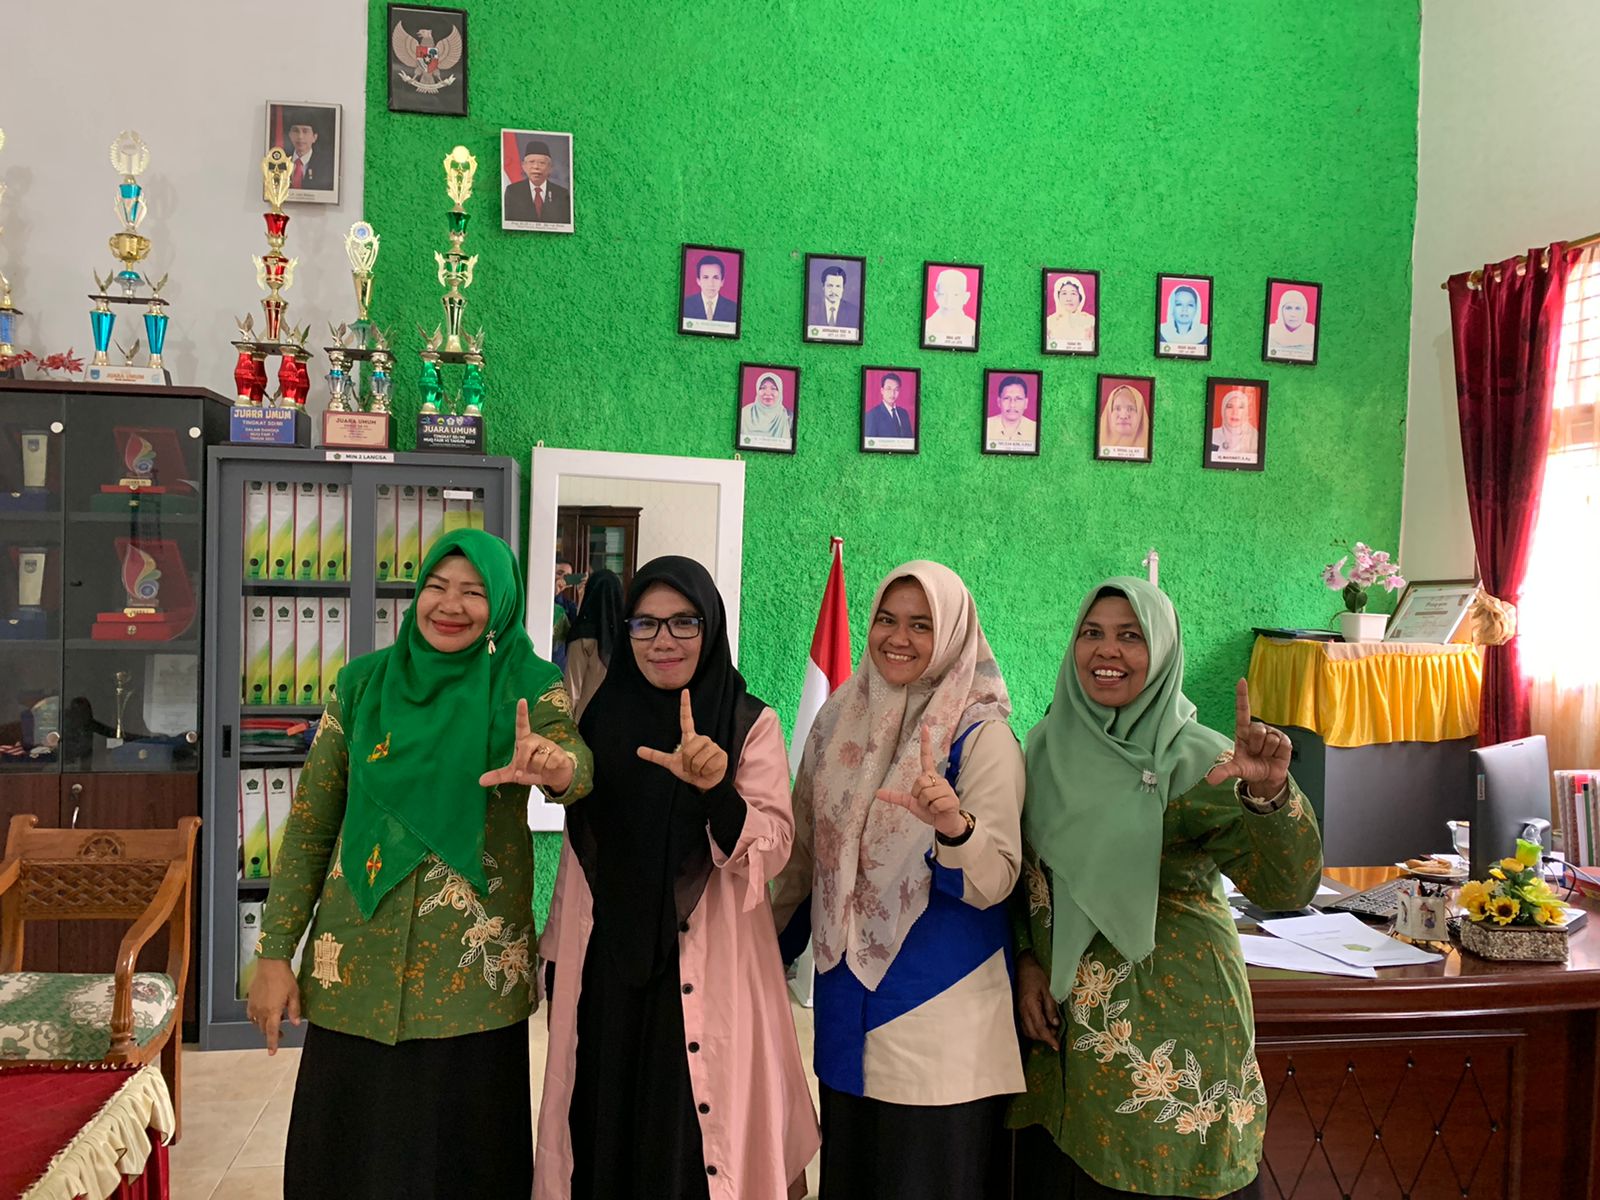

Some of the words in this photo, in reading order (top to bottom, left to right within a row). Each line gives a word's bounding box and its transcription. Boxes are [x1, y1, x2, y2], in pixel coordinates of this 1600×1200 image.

[234, 409, 263, 418] JUARA
[265, 410, 291, 419] UMUM
[451, 427, 476, 435] UMUM
